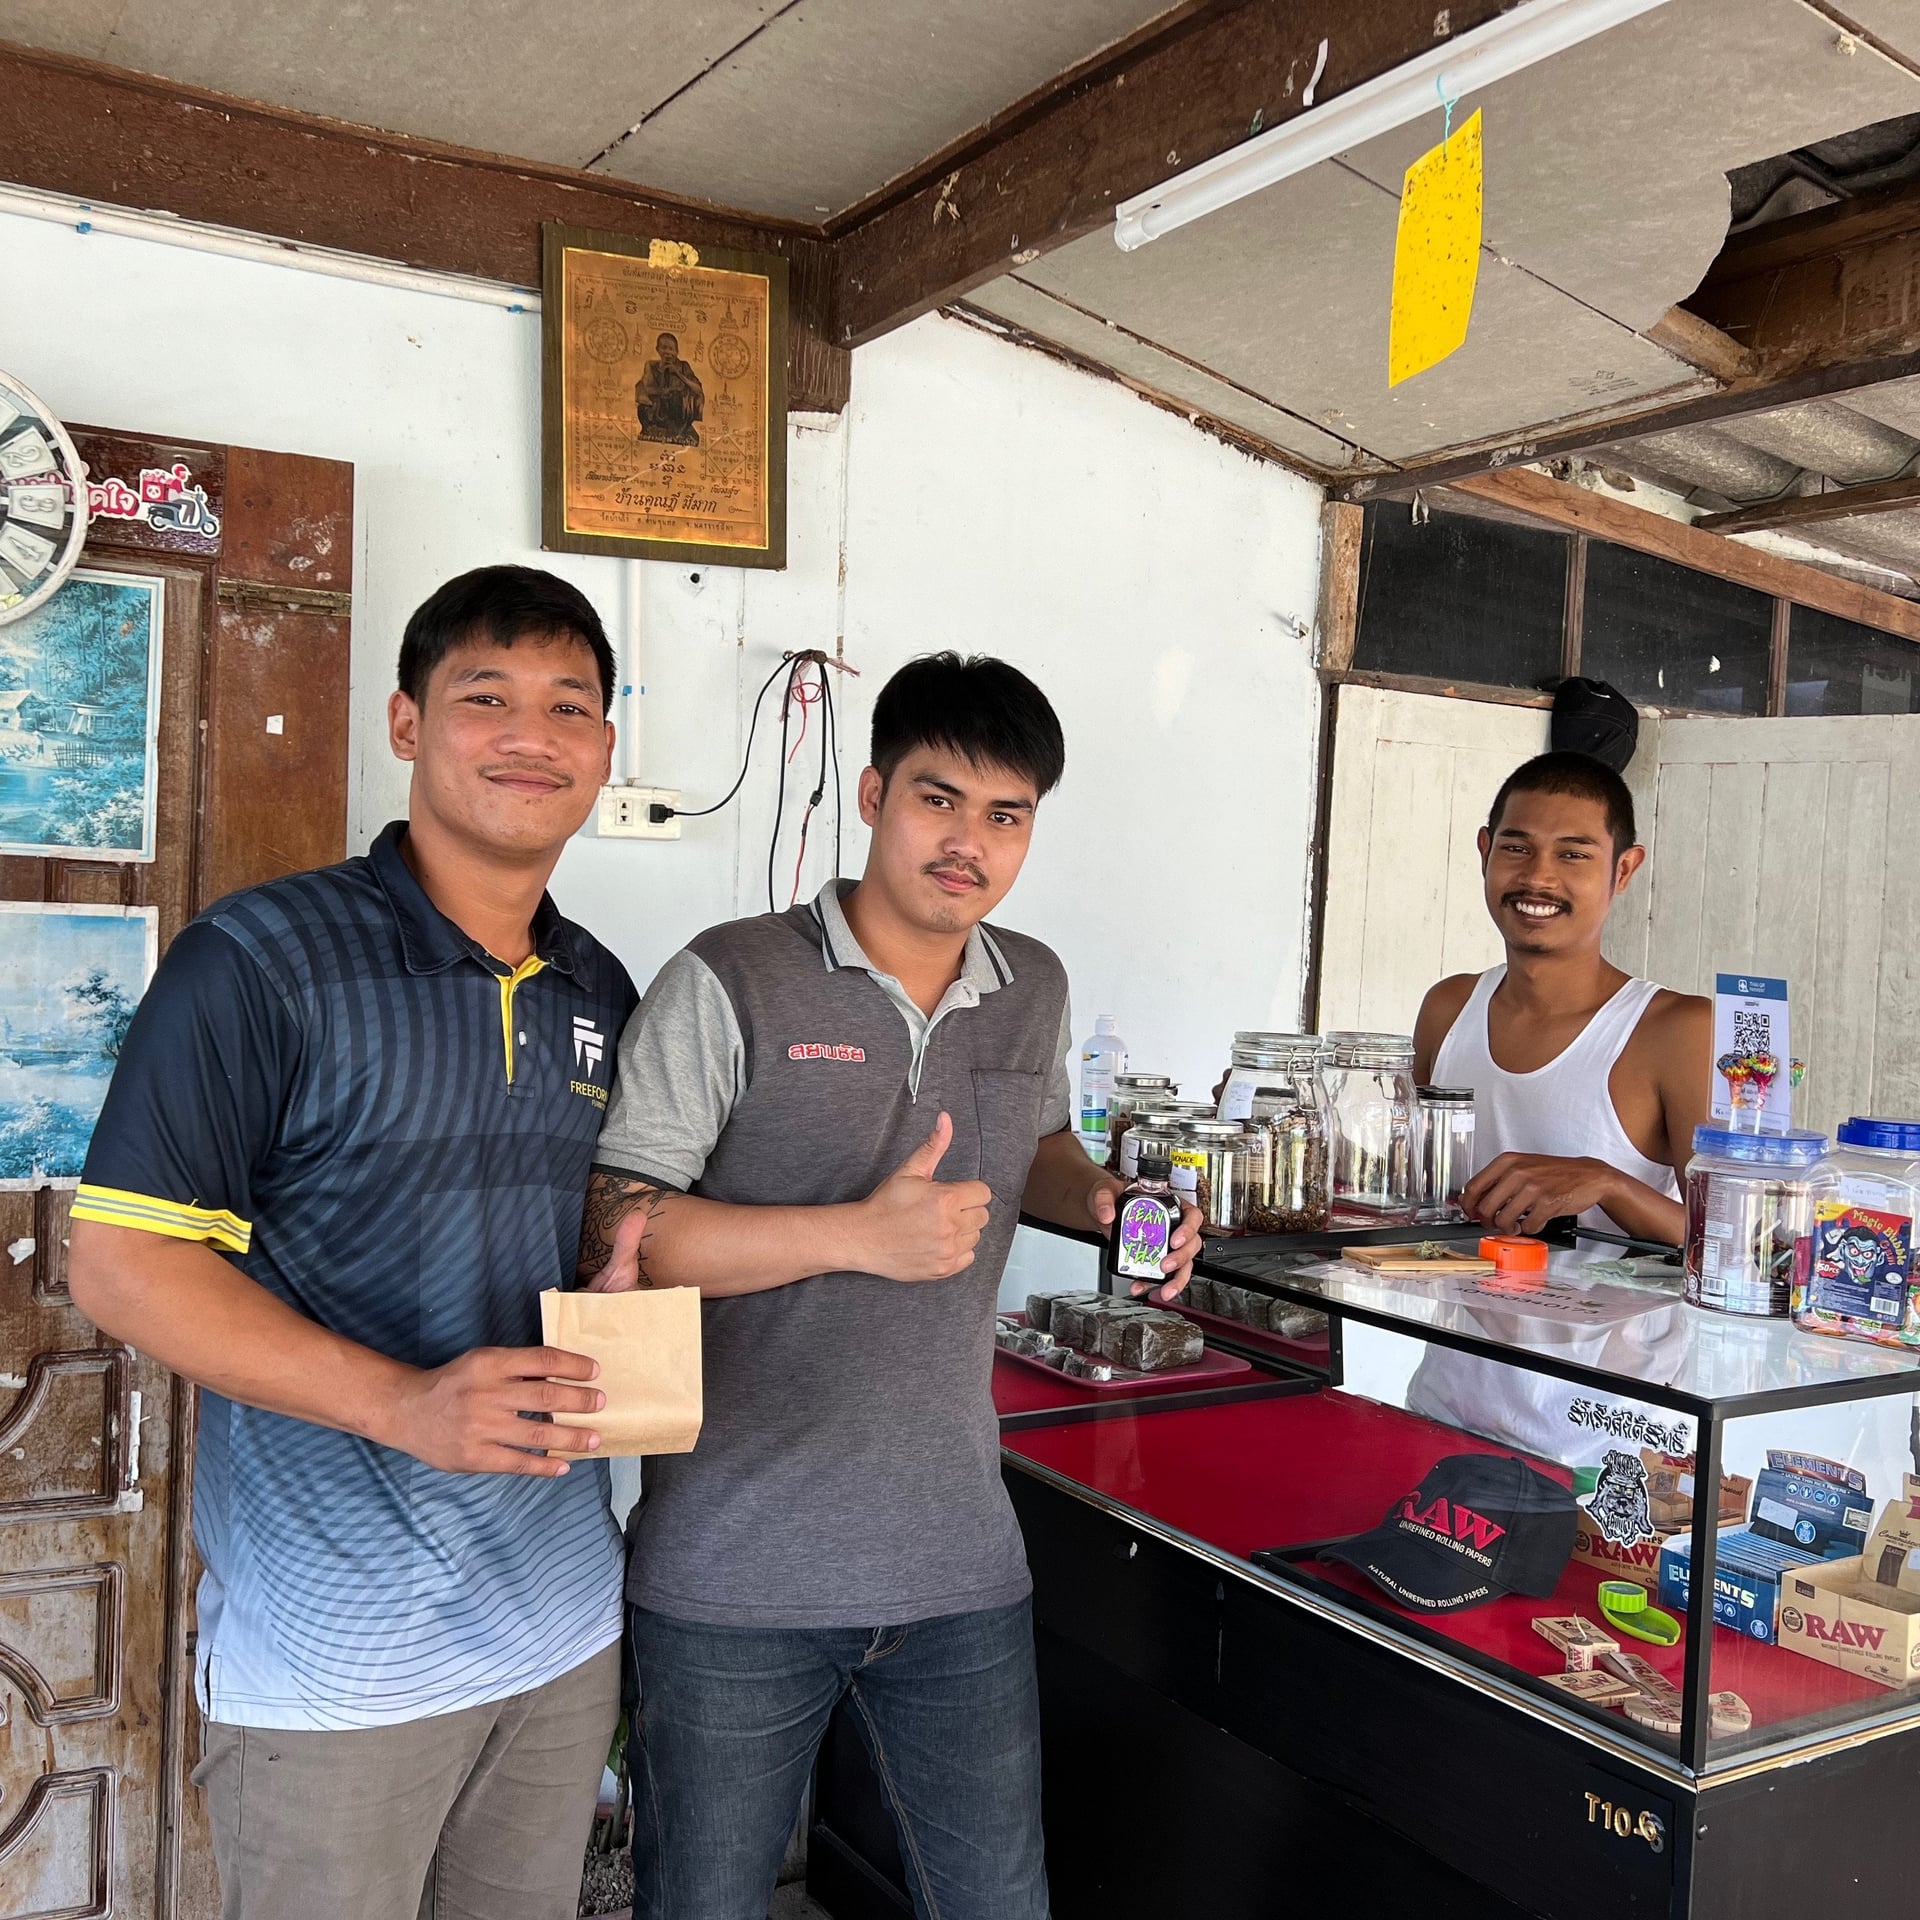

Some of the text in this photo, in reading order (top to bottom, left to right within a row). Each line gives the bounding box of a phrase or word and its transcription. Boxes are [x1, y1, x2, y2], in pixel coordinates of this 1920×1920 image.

[788, 1043, 866, 1062] สยามชัย
[1126, 1206, 1166, 1226] LEAN
[1124, 1242, 1162, 1267] THC
[1852, 1208, 1884, 1231] Magic
[1882, 1226, 1907, 1267] Bubble
[1771, 1451, 1864, 1492] ELEMENTS
[1392, 1490, 1507, 1550] RAW
[1399, 1519, 1493, 1568] UNREFINED ROLLING PAPERS
[1588, 1534, 1661, 1569] RAW
[1367, 1564, 1489, 1608] NATURAL UNREFINED ROLLING PAPERS
[1804, 1612, 1888, 1651] RAW
